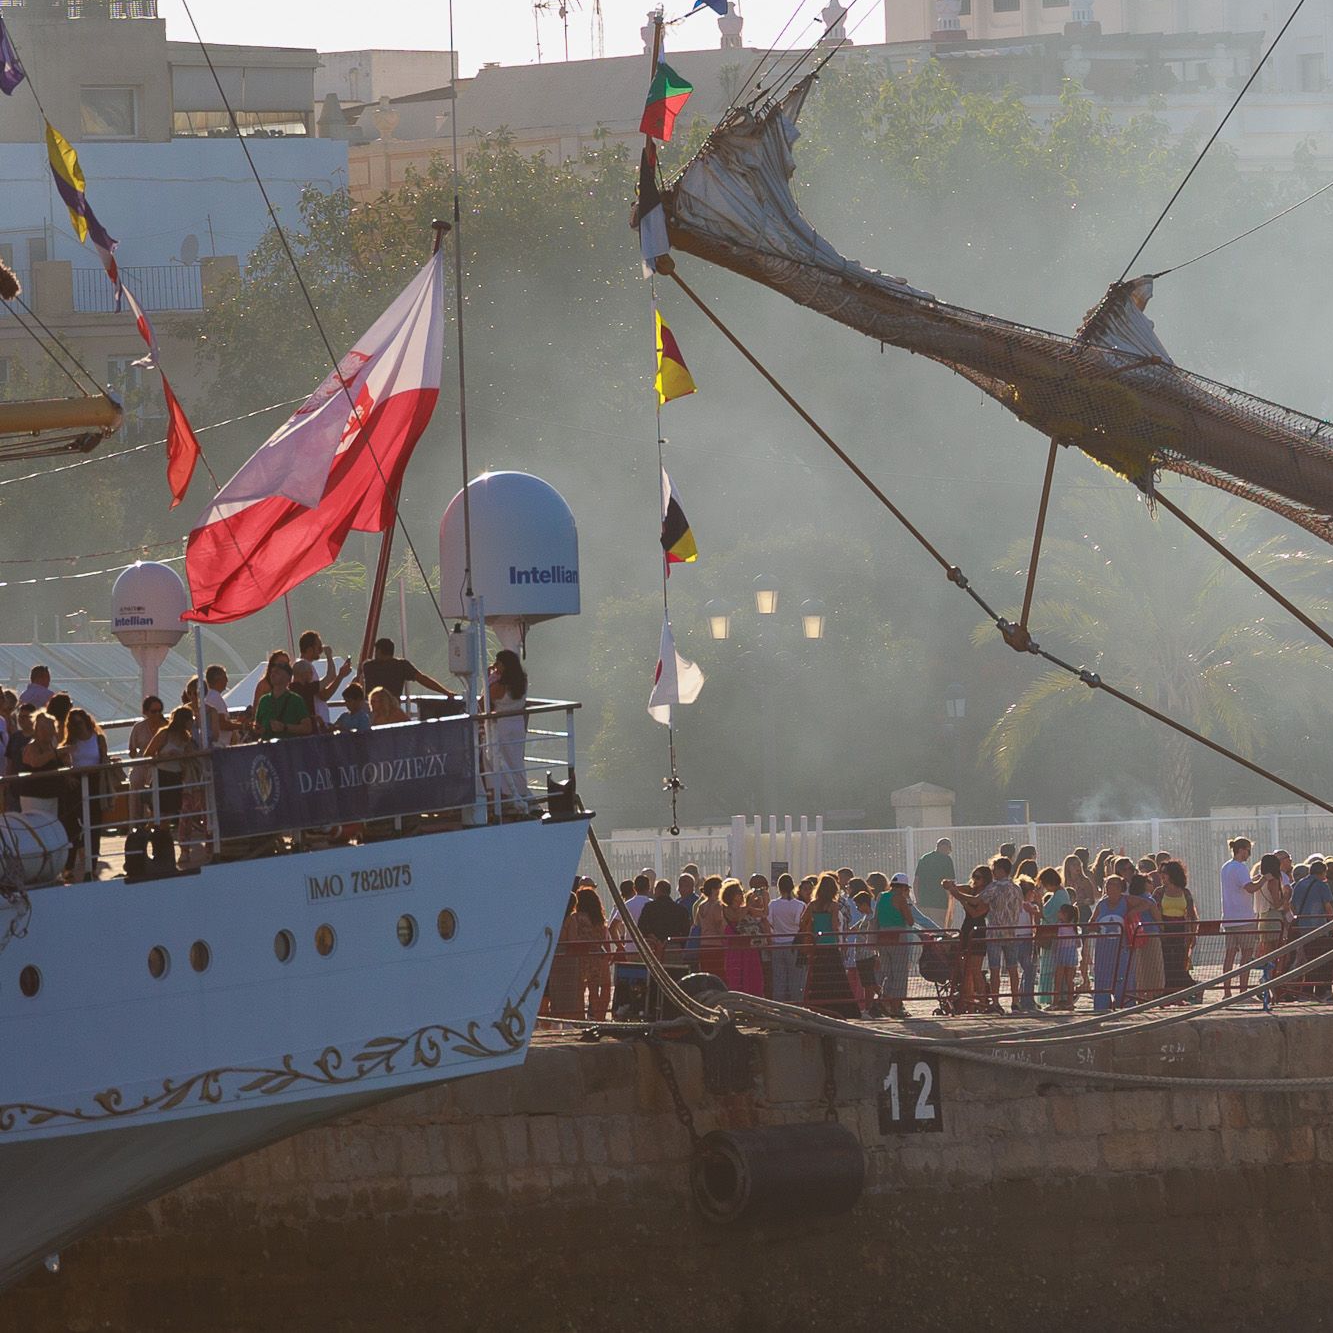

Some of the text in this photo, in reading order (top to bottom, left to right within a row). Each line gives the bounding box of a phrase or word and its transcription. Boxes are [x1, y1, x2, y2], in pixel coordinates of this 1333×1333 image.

[509, 565, 579, 585] Intellian
[114, 615, 154, 627] Intellian
[309, 864, 412, 900] IMO 7821075
[884, 1061, 936, 1121] 12
